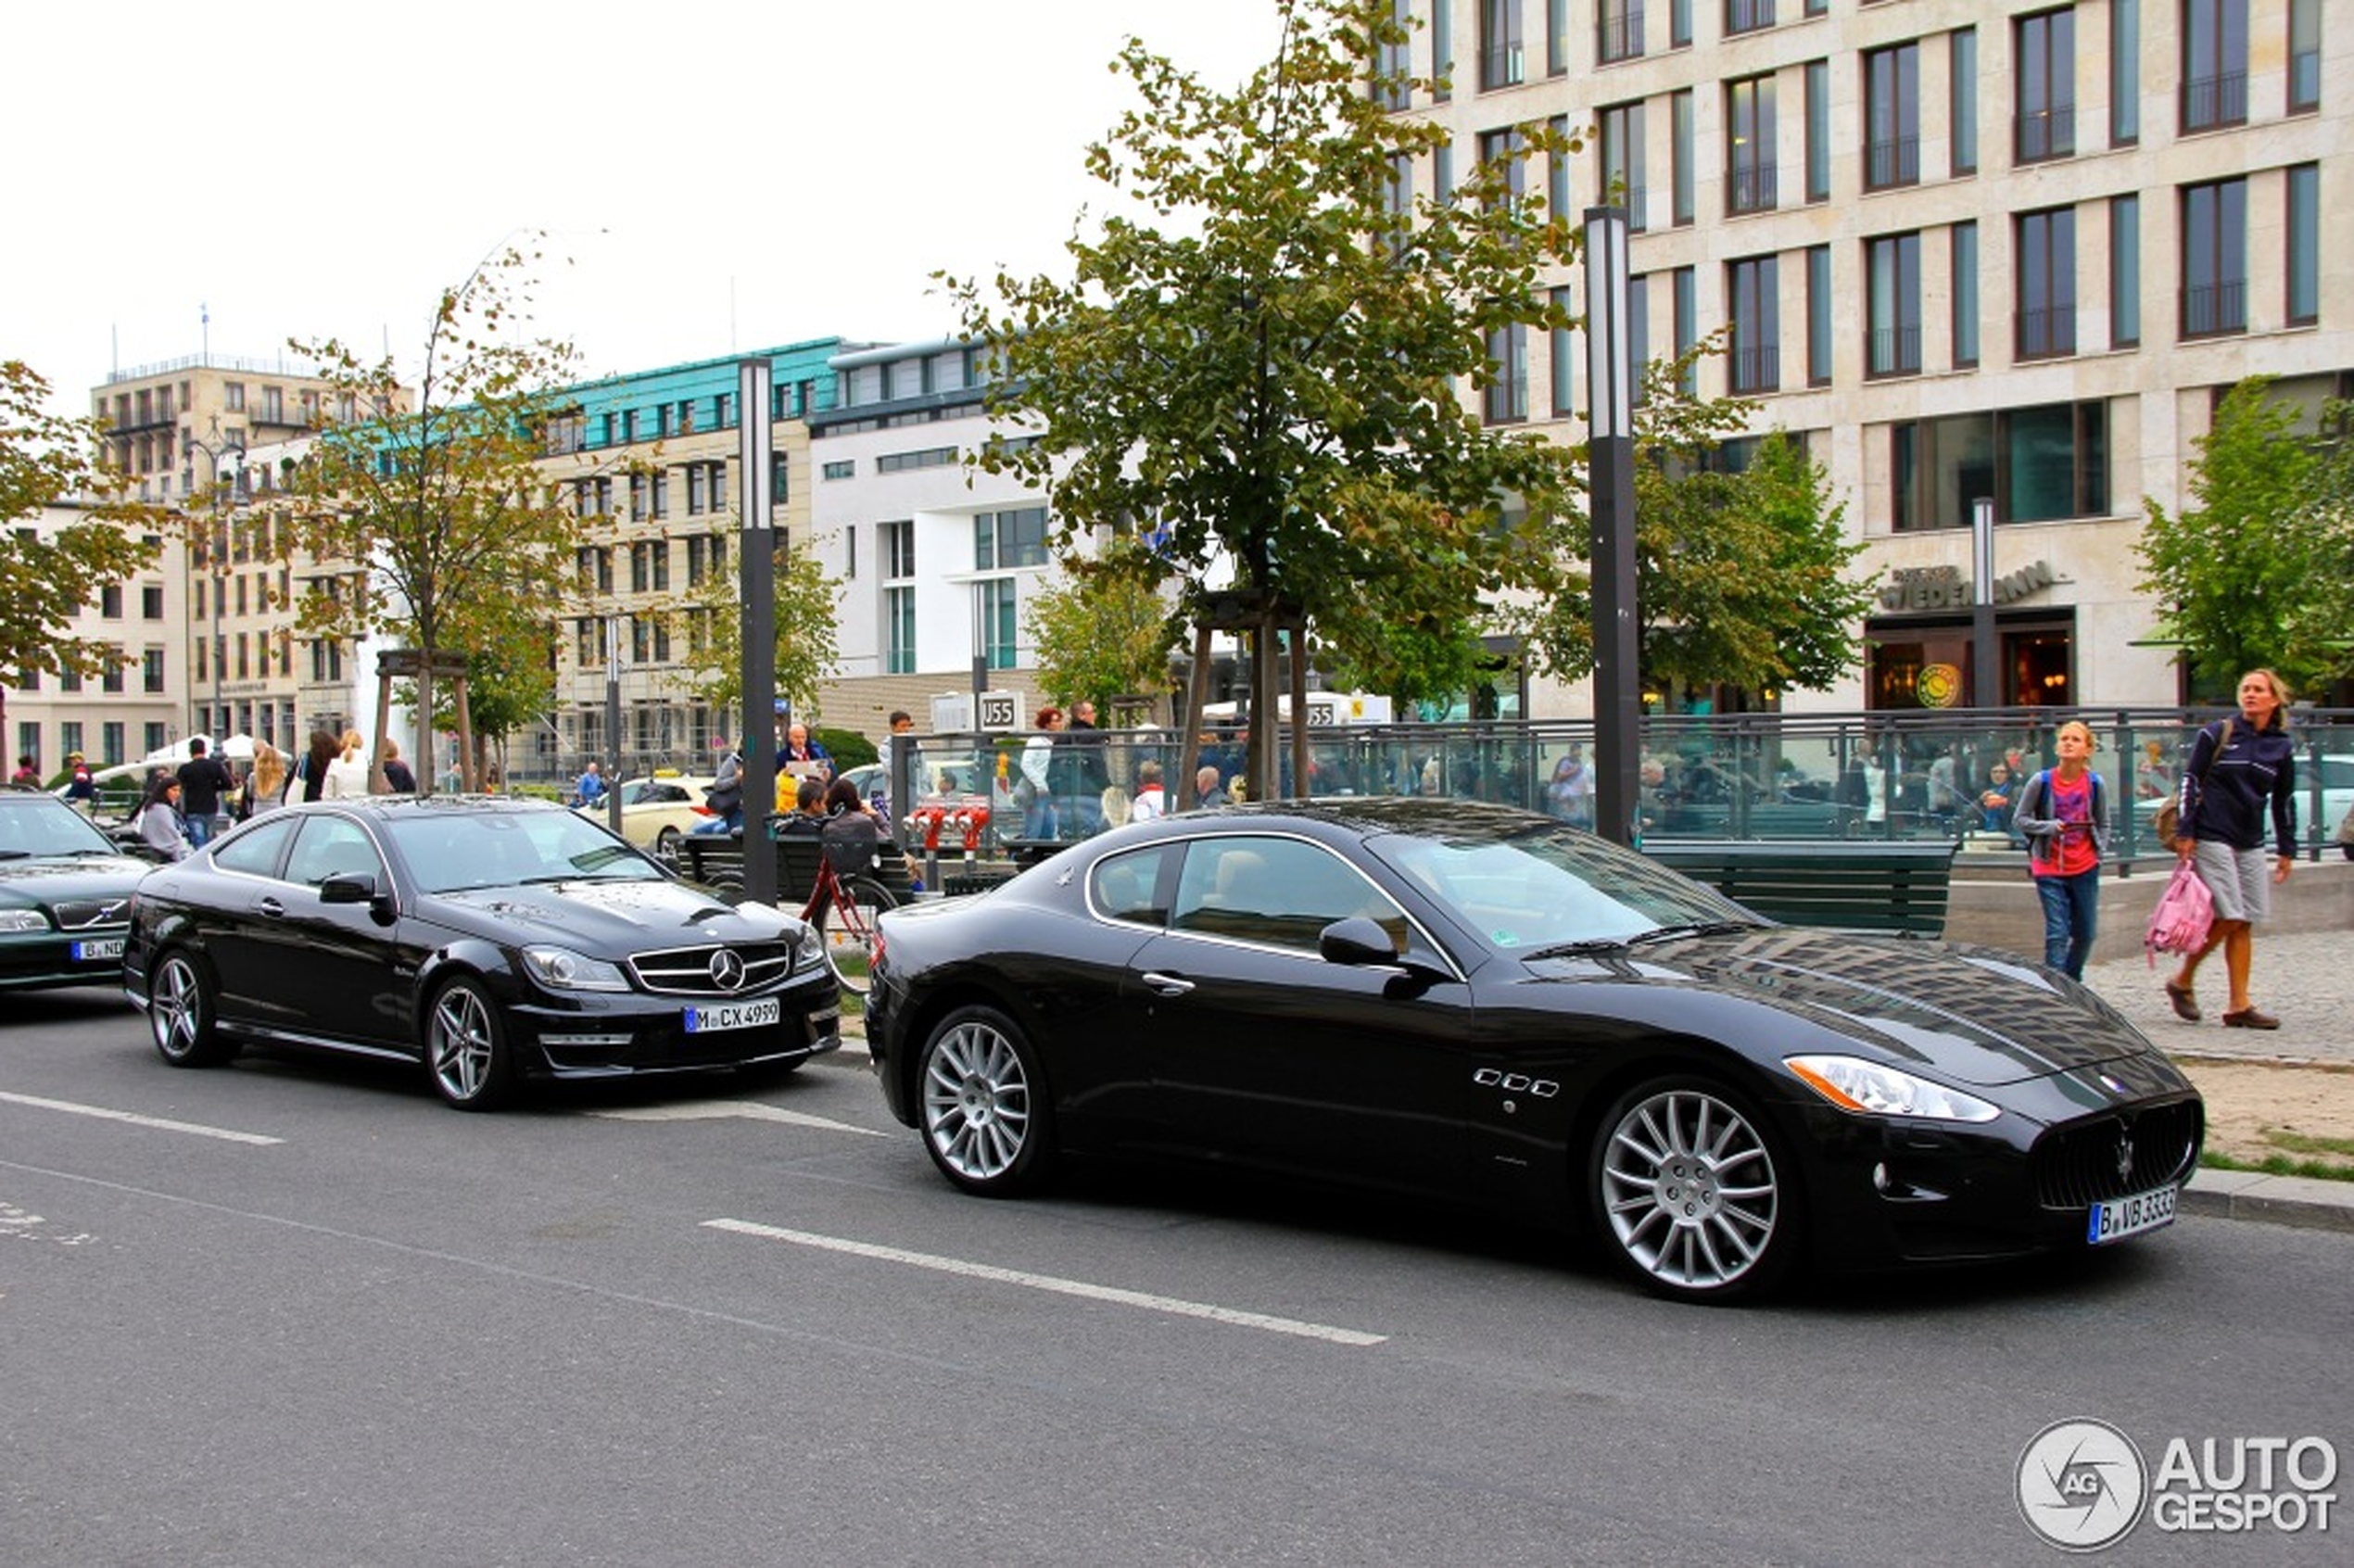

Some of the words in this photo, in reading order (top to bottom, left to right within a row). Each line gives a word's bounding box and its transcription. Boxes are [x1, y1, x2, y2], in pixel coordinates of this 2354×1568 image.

[698, 1011, 709, 1029] M
[720, 1007, 741, 1027] CX
[2101, 1207, 2111, 1235] B
